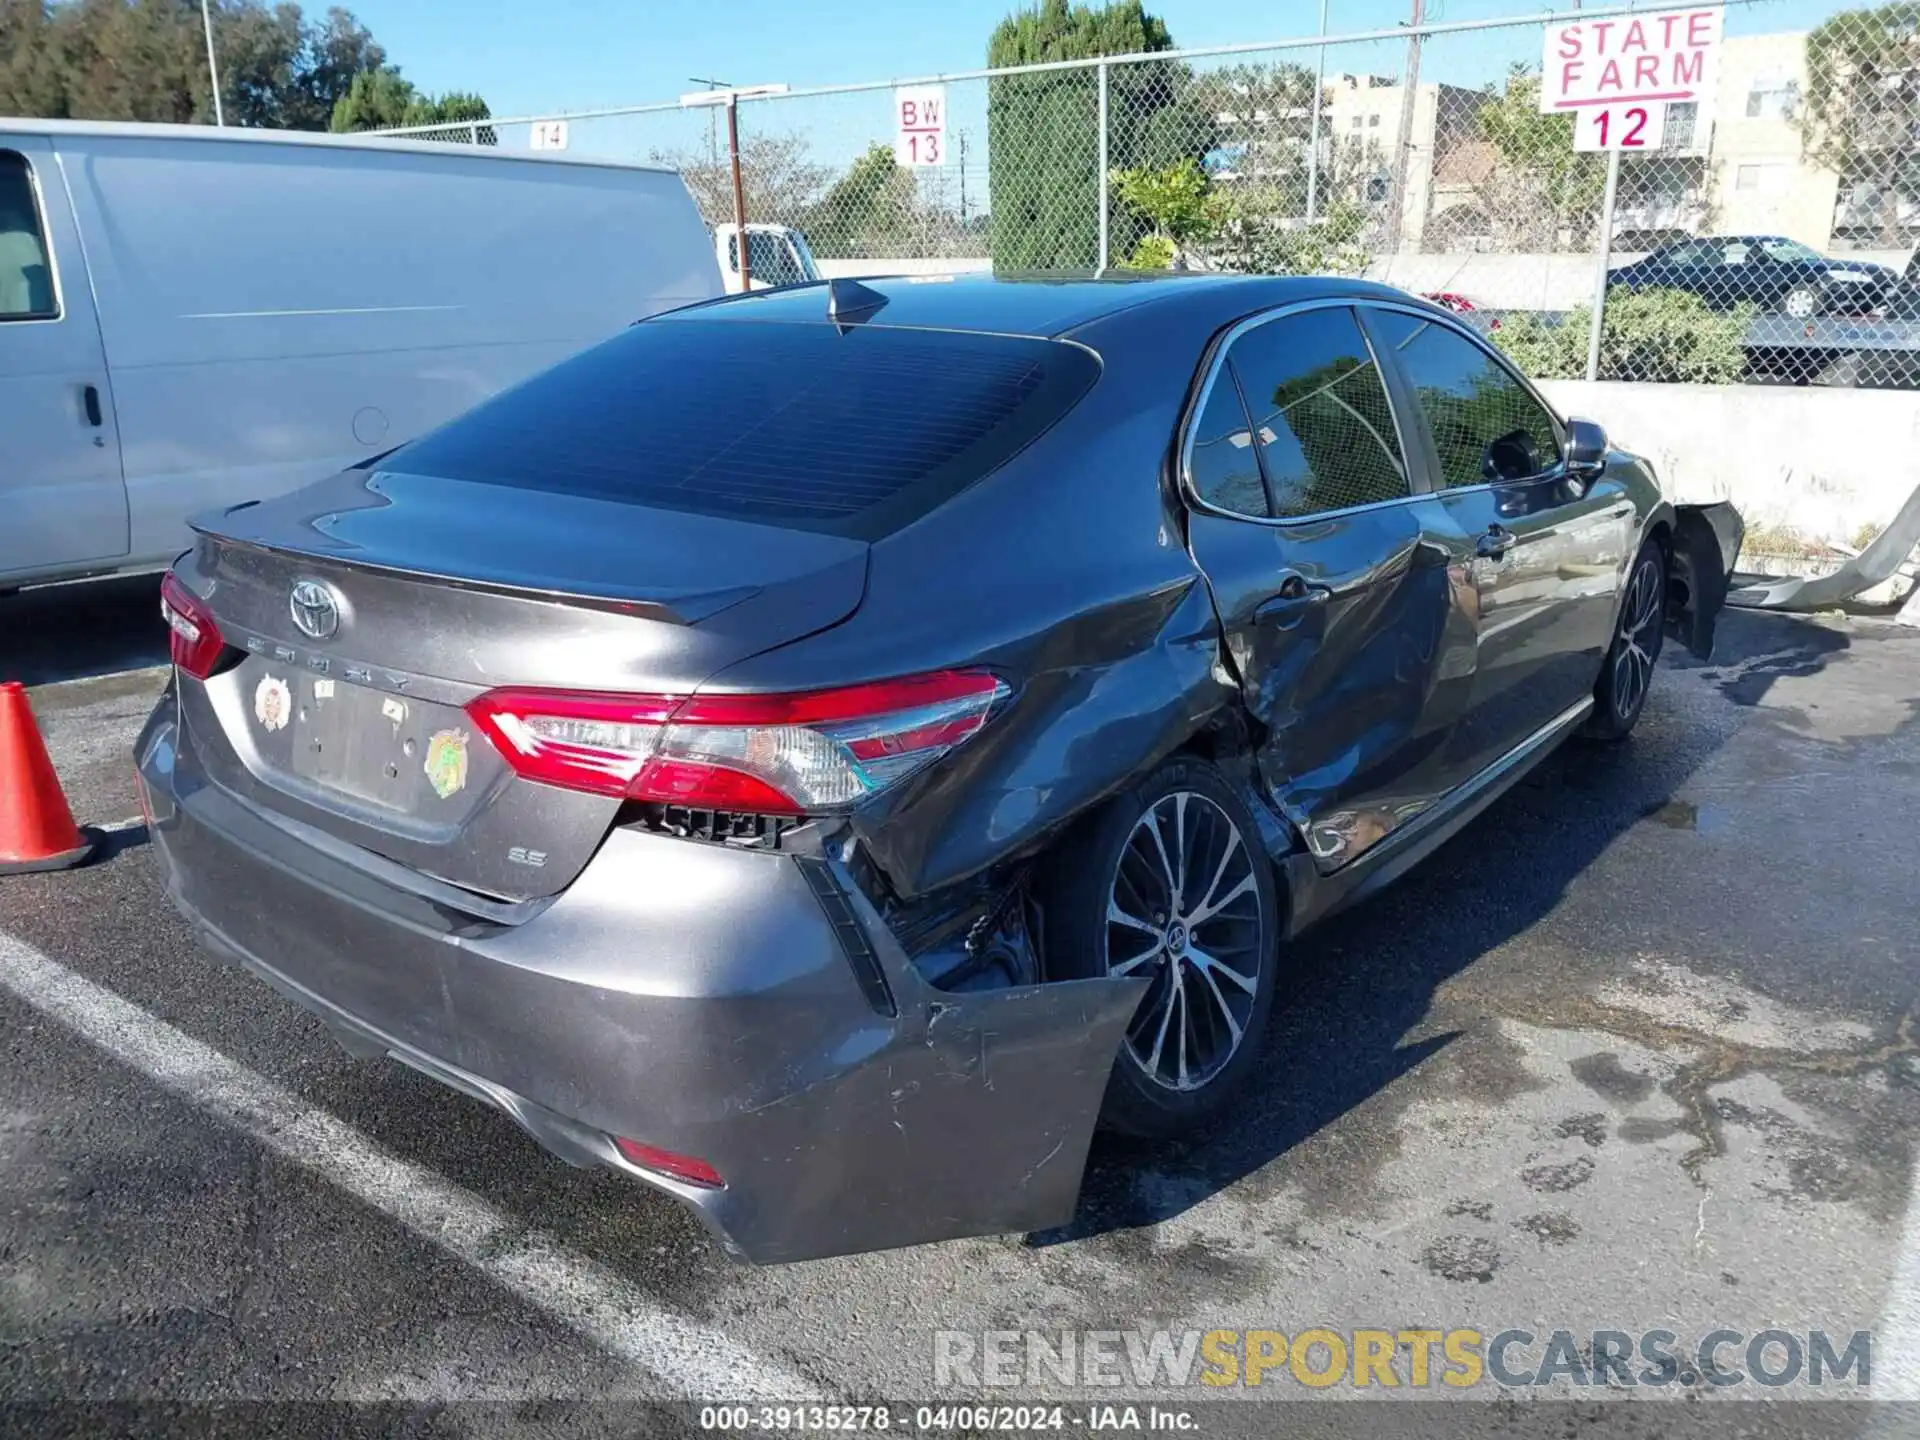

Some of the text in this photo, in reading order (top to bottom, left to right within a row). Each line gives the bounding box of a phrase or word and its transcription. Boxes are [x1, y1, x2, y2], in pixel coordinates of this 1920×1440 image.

[1558, 12, 1714, 59] STATE
[1561, 50, 1704, 96] FARM
[902, 100, 940, 126] BW
[1593, 107, 1648, 148] 12
[540, 123, 561, 148] 14
[908, 134, 939, 164] 13
